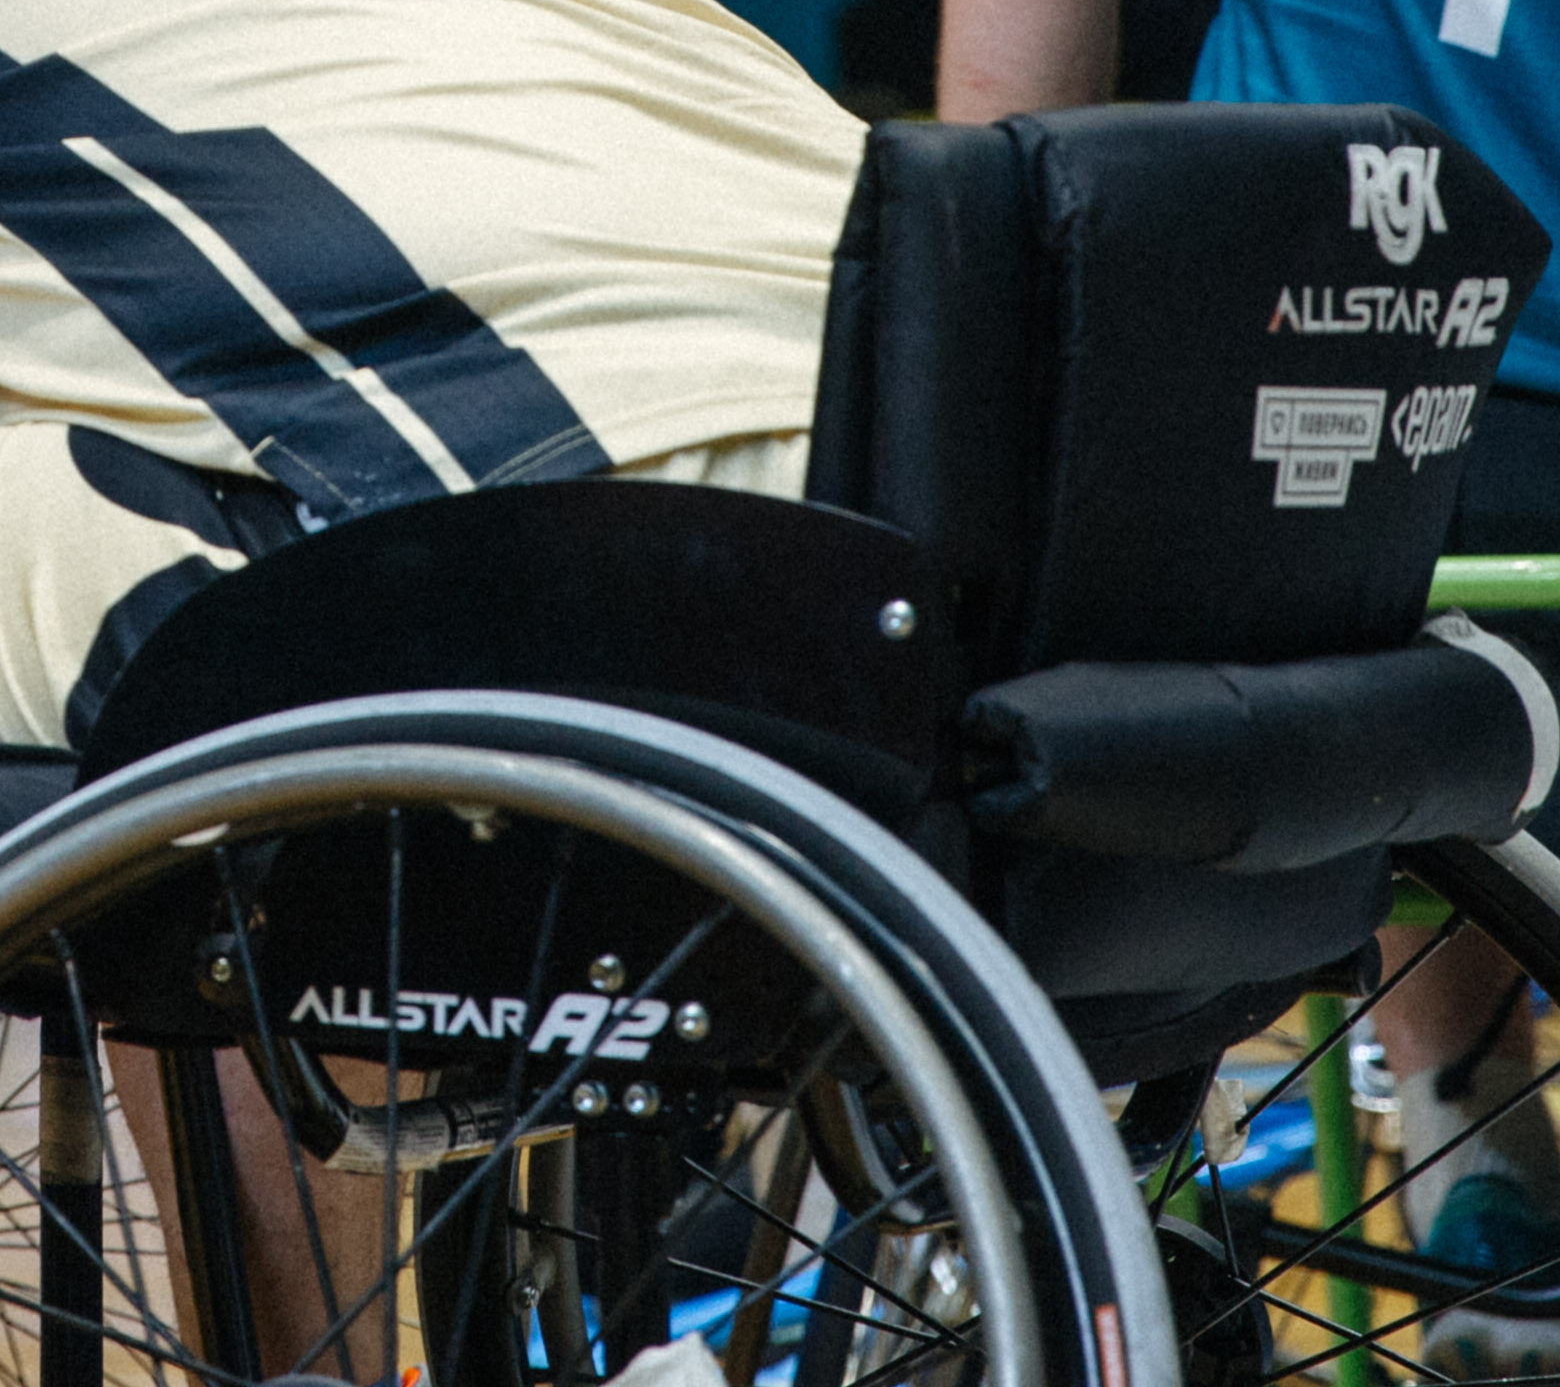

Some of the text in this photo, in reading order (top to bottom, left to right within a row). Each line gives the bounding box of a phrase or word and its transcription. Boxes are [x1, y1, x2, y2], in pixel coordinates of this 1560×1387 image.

[1268, 277, 1510, 348] ALLSTAR A2
[288, 985, 671, 1061] ALLSTAR A2
